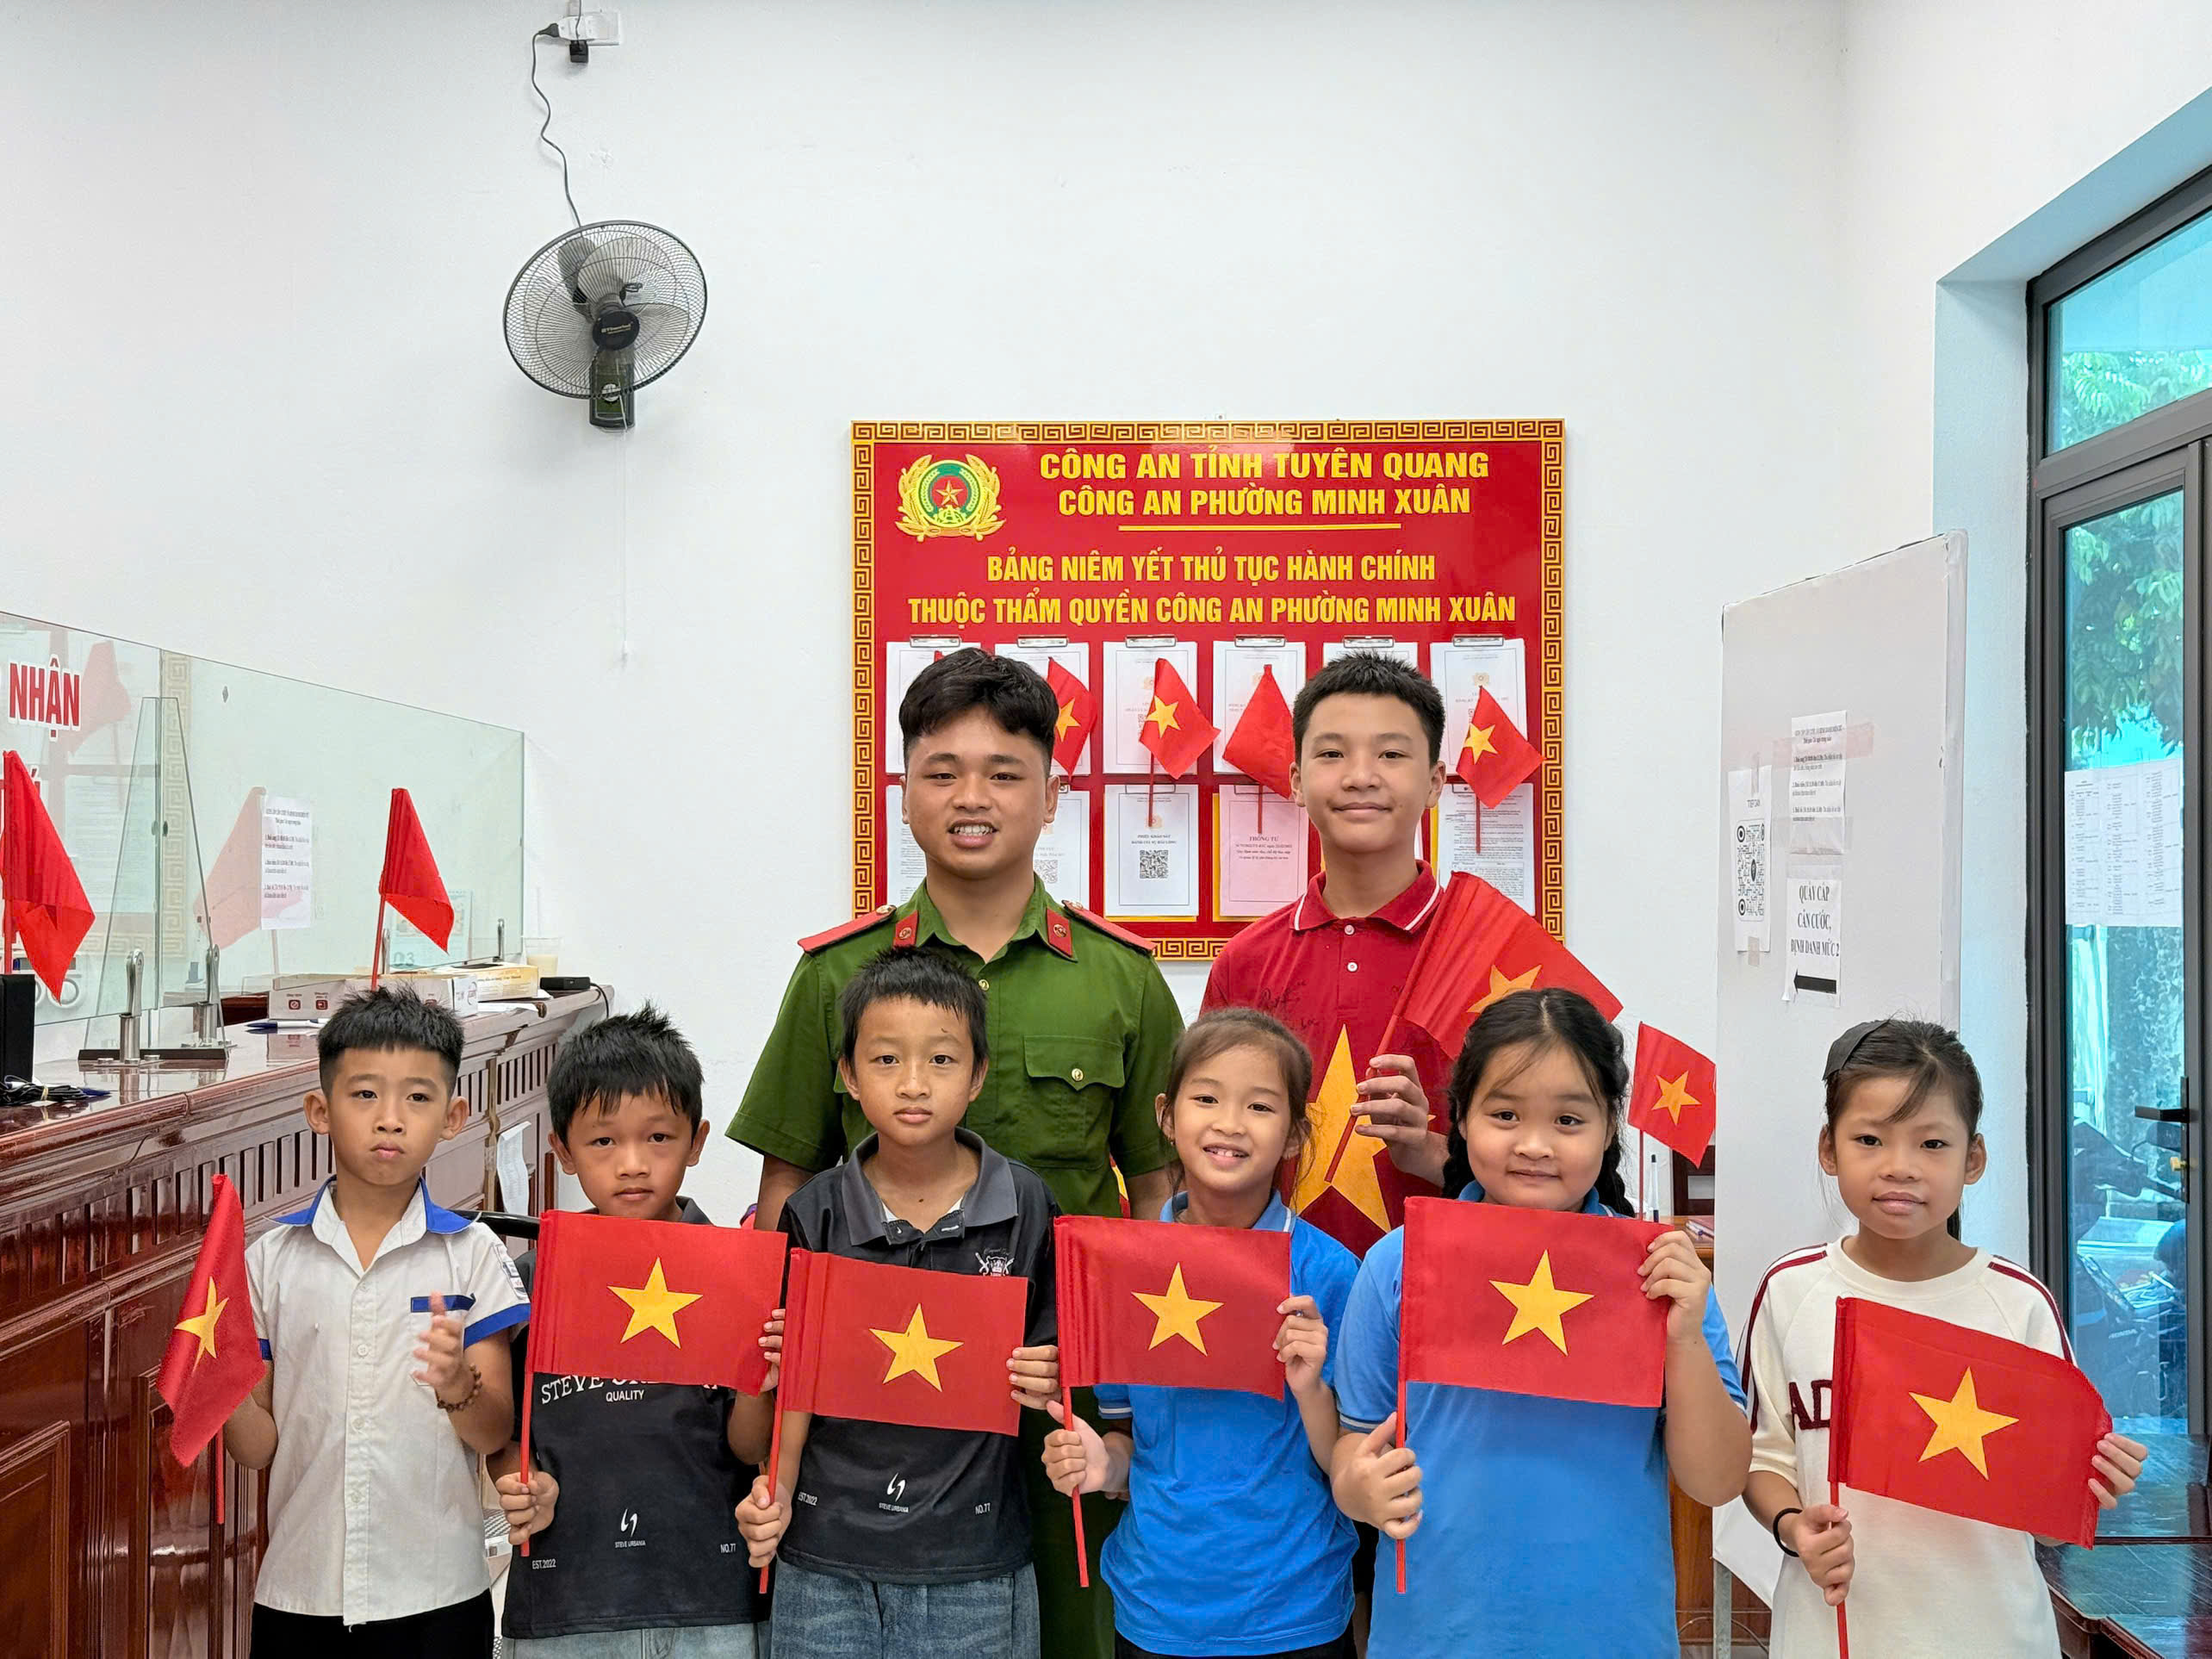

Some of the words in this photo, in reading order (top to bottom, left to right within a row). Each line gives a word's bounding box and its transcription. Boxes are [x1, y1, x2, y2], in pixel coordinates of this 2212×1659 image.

[1040, 447, 1126, 479] CÔNG
[1136, 453, 1180, 479] AN
[1190, 444, 1262, 479] TỈNH
[1274, 446, 1372, 478] TUYÊN
[1382, 451, 1489, 481] QUANG
[1059, 484, 1134, 516] CÔNG
[1142, 489, 1181, 515] AN
[1190, 482, 1302, 516] PHƯỜNG
[1312, 489, 1385, 515] MINH
[1394, 483, 1469, 514] XUÂN
[987, 546, 1053, 581] BẢNG
[1061, 550, 1124, 581] NIÊM
[1131, 546, 1174, 581] YẾT
[1180, 545, 1227, 581] THỦ
[1233, 555, 1279, 587] TỤC
[1287, 549, 1353, 581] HÀNH
[1360, 549, 1435, 581] CHÍNH
[908, 591, 986, 629] THUỘC
[992, 587, 1061, 624] THẨM
[1069, 588, 1148, 626] QUYỀN
[1156, 592, 1221, 624] CÔNG
[1229, 597, 1263, 624] AN
[1271, 590, 1370, 624] PHƯỜNG
[1376, 597, 1440, 623] MINH
[1448, 591, 1516, 622] XUÂN
[9, 657, 80, 738] NHẬN
[541, 1375, 604, 1404] STEVE
[606, 1389, 644, 1402] QUALITY
[532, 1558, 556, 1569] EST.2022
